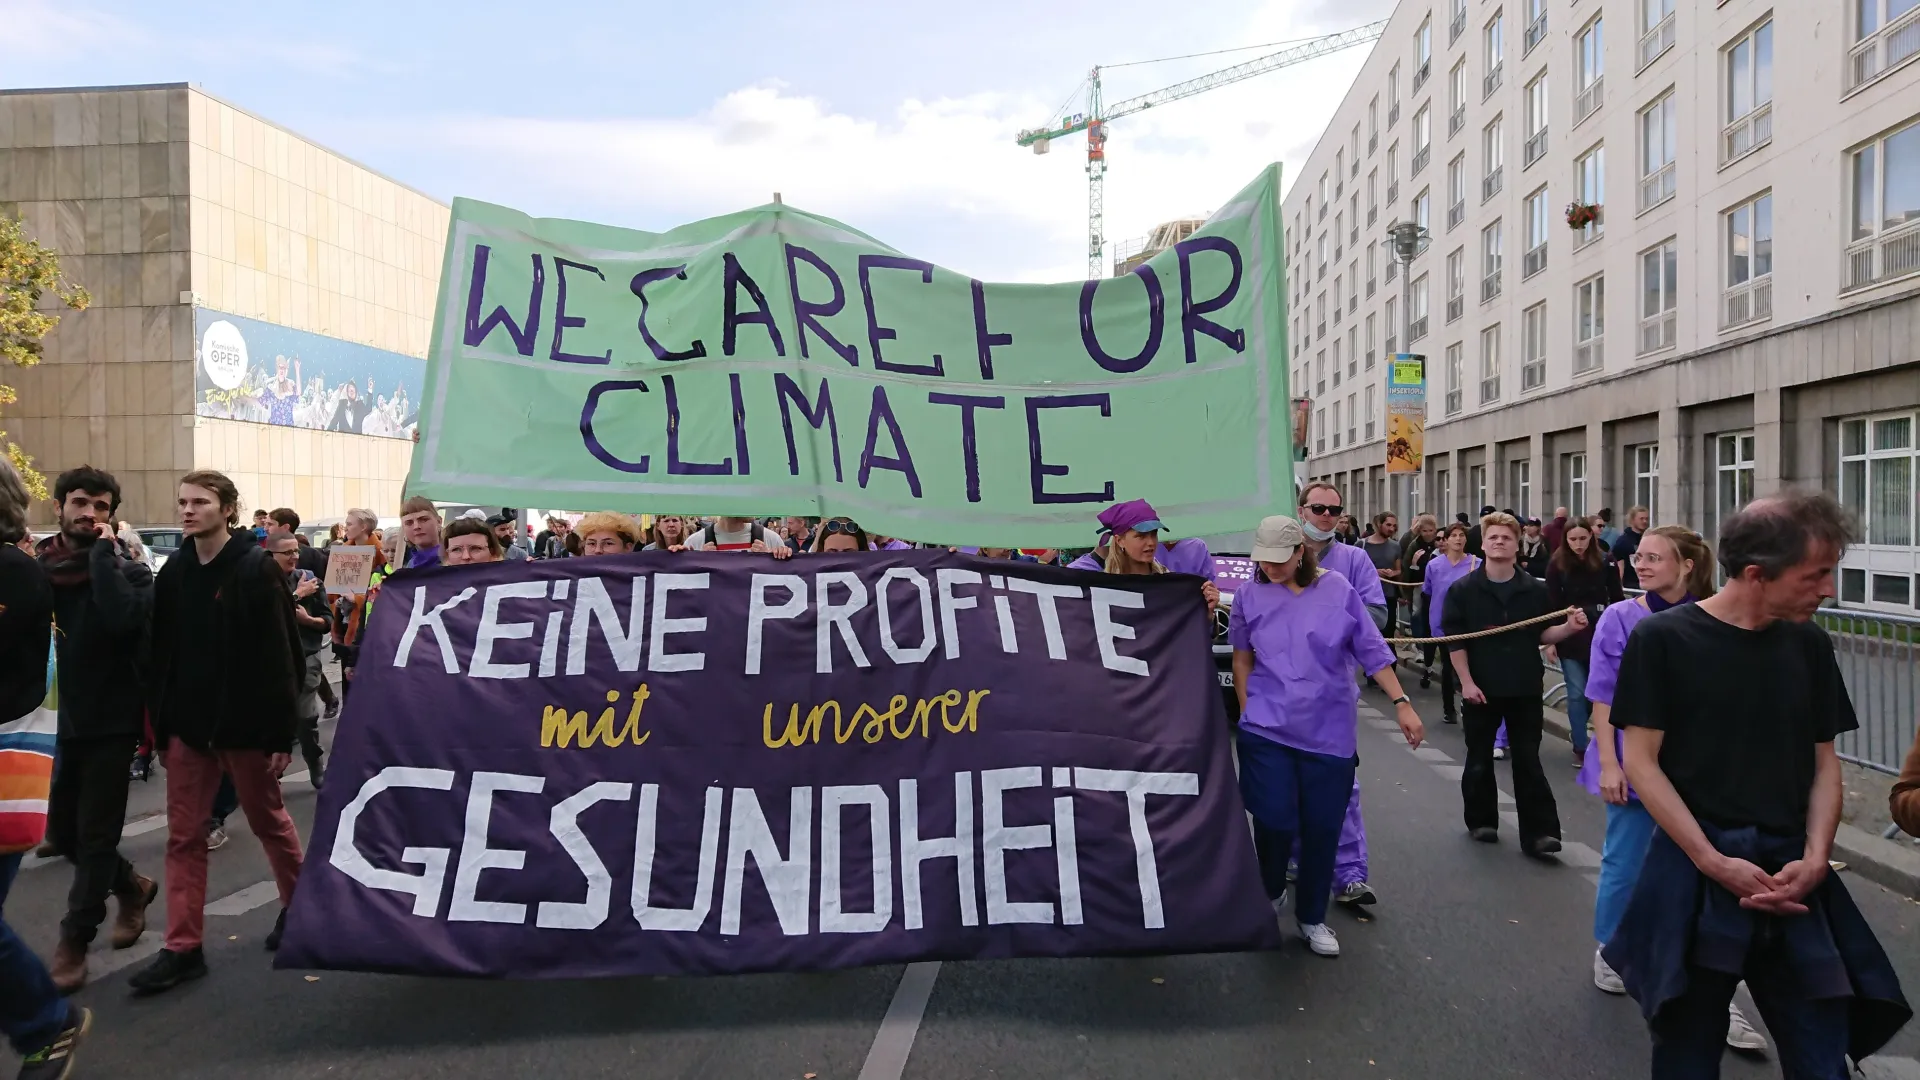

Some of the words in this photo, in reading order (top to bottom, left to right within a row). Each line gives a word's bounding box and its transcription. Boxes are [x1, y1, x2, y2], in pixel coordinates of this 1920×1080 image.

[463, 244, 612, 365] WE
[629, 243, 944, 378] CARE
[211, 340, 240, 353] Komische
[211, 350, 240, 367] OPER
[1389, 387, 1424, 395] INSEKTOPIA
[578, 373, 1116, 503] CLIMATE
[336, 574, 361, 586] PLANET
[539, 683, 651, 750] mit
[763, 688, 990, 748] unserer
